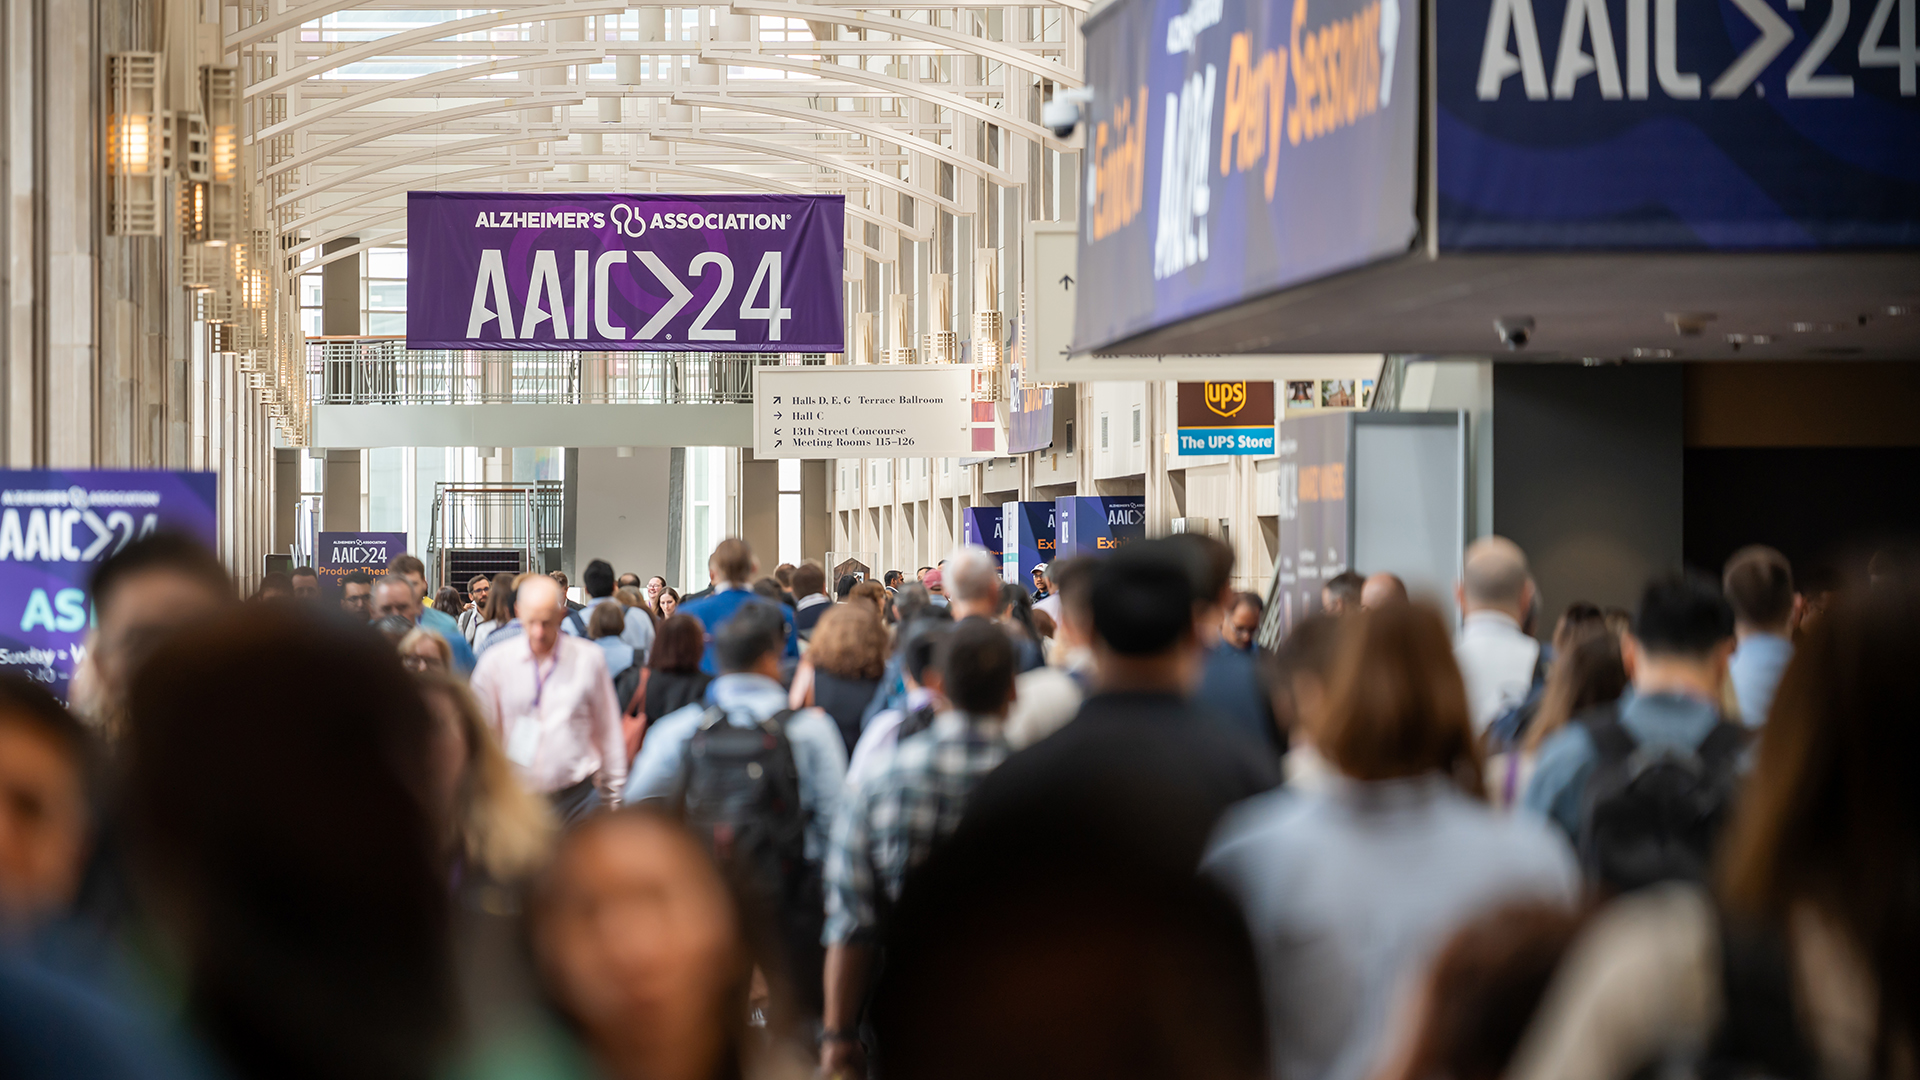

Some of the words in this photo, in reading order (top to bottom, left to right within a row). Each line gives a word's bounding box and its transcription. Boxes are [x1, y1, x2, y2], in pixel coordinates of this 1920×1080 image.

[475, 210, 605, 230] ALZHEIMER'S
[792, 396, 816, 405] Halls
[843, 396, 851, 405] G
[858, 395, 896, 405] Terrace
[899, 395, 943, 405] Ballroom
[792, 411, 813, 420] Hall
[816, 411, 824, 420] C
[793, 427, 814, 436] 13th
[817, 426, 848, 436] Street
[852, 426, 906, 436] Concourse
[792, 437, 833, 449] Meeting
[836, 437, 871, 447] Rooms
[1180, 436, 1205, 449] The
[1208, 435, 1235, 448] UPS
[361, 567, 389, 575] Theat
